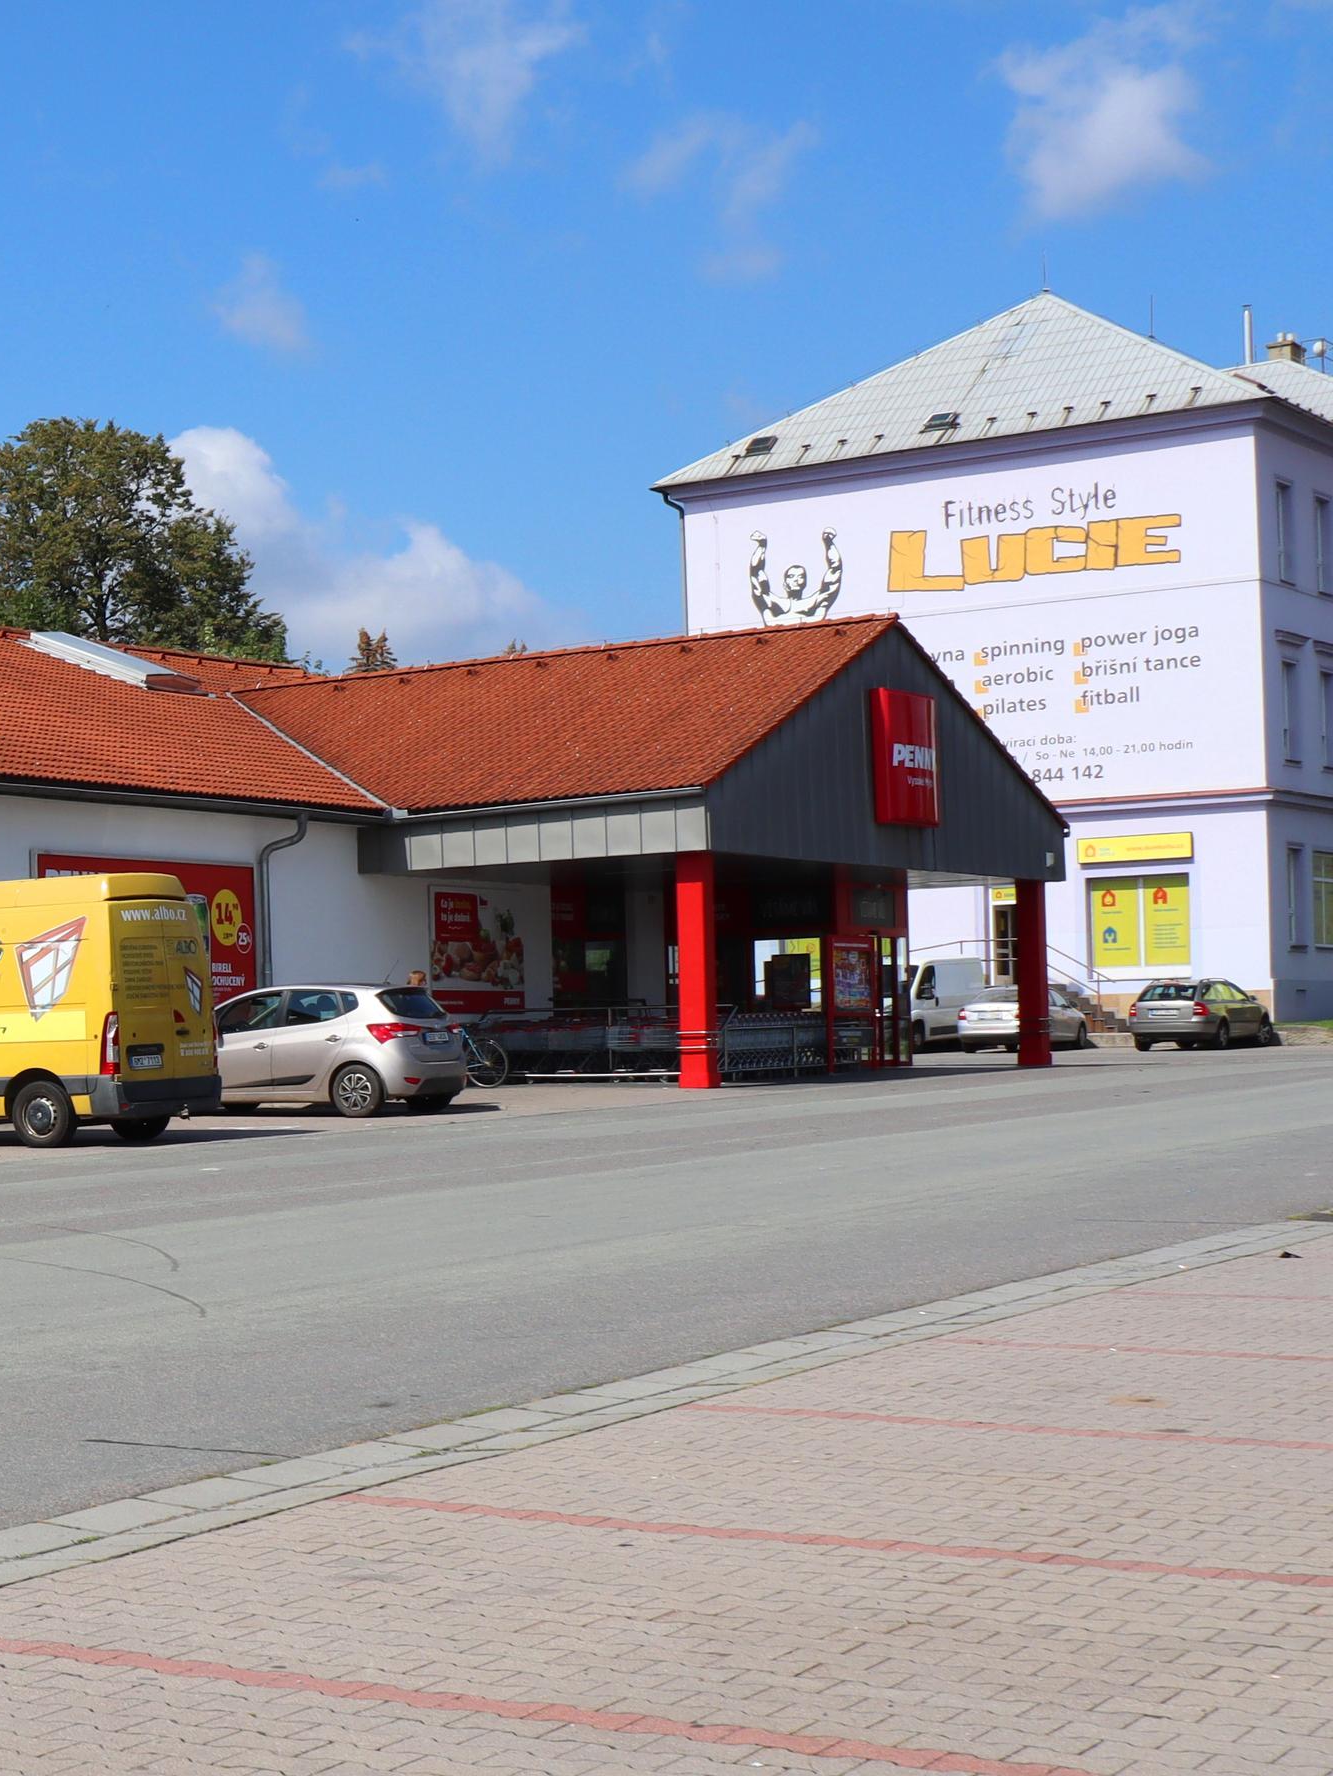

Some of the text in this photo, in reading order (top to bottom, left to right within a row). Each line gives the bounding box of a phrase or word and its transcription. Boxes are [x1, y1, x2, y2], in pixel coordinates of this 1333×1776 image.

[944, 482, 1117, 532] Fitness Style
[887, 514, 1181, 593] LUCIE
[981, 637, 1065, 661] spinning
[1081, 624, 1200, 653] power joga
[981, 666, 1054, 687] aerobic
[1081, 654, 1202, 678] břišní tance
[982, 696, 1047, 719] pilates
[1080, 686, 1141, 707] fitball
[1035, 751, 1050, 762] So
[1059, 750, 1076, 760] Ne
[1159, 740, 1194, 753] hodin
[1040, 734, 1077, 746] doba:
[1032, 764, 1104, 786] 844 142
[121, 905, 188, 922] www.albo.cz
[175, 940, 198, 955] ALBO
[212, 963, 232, 973] BIRELL
